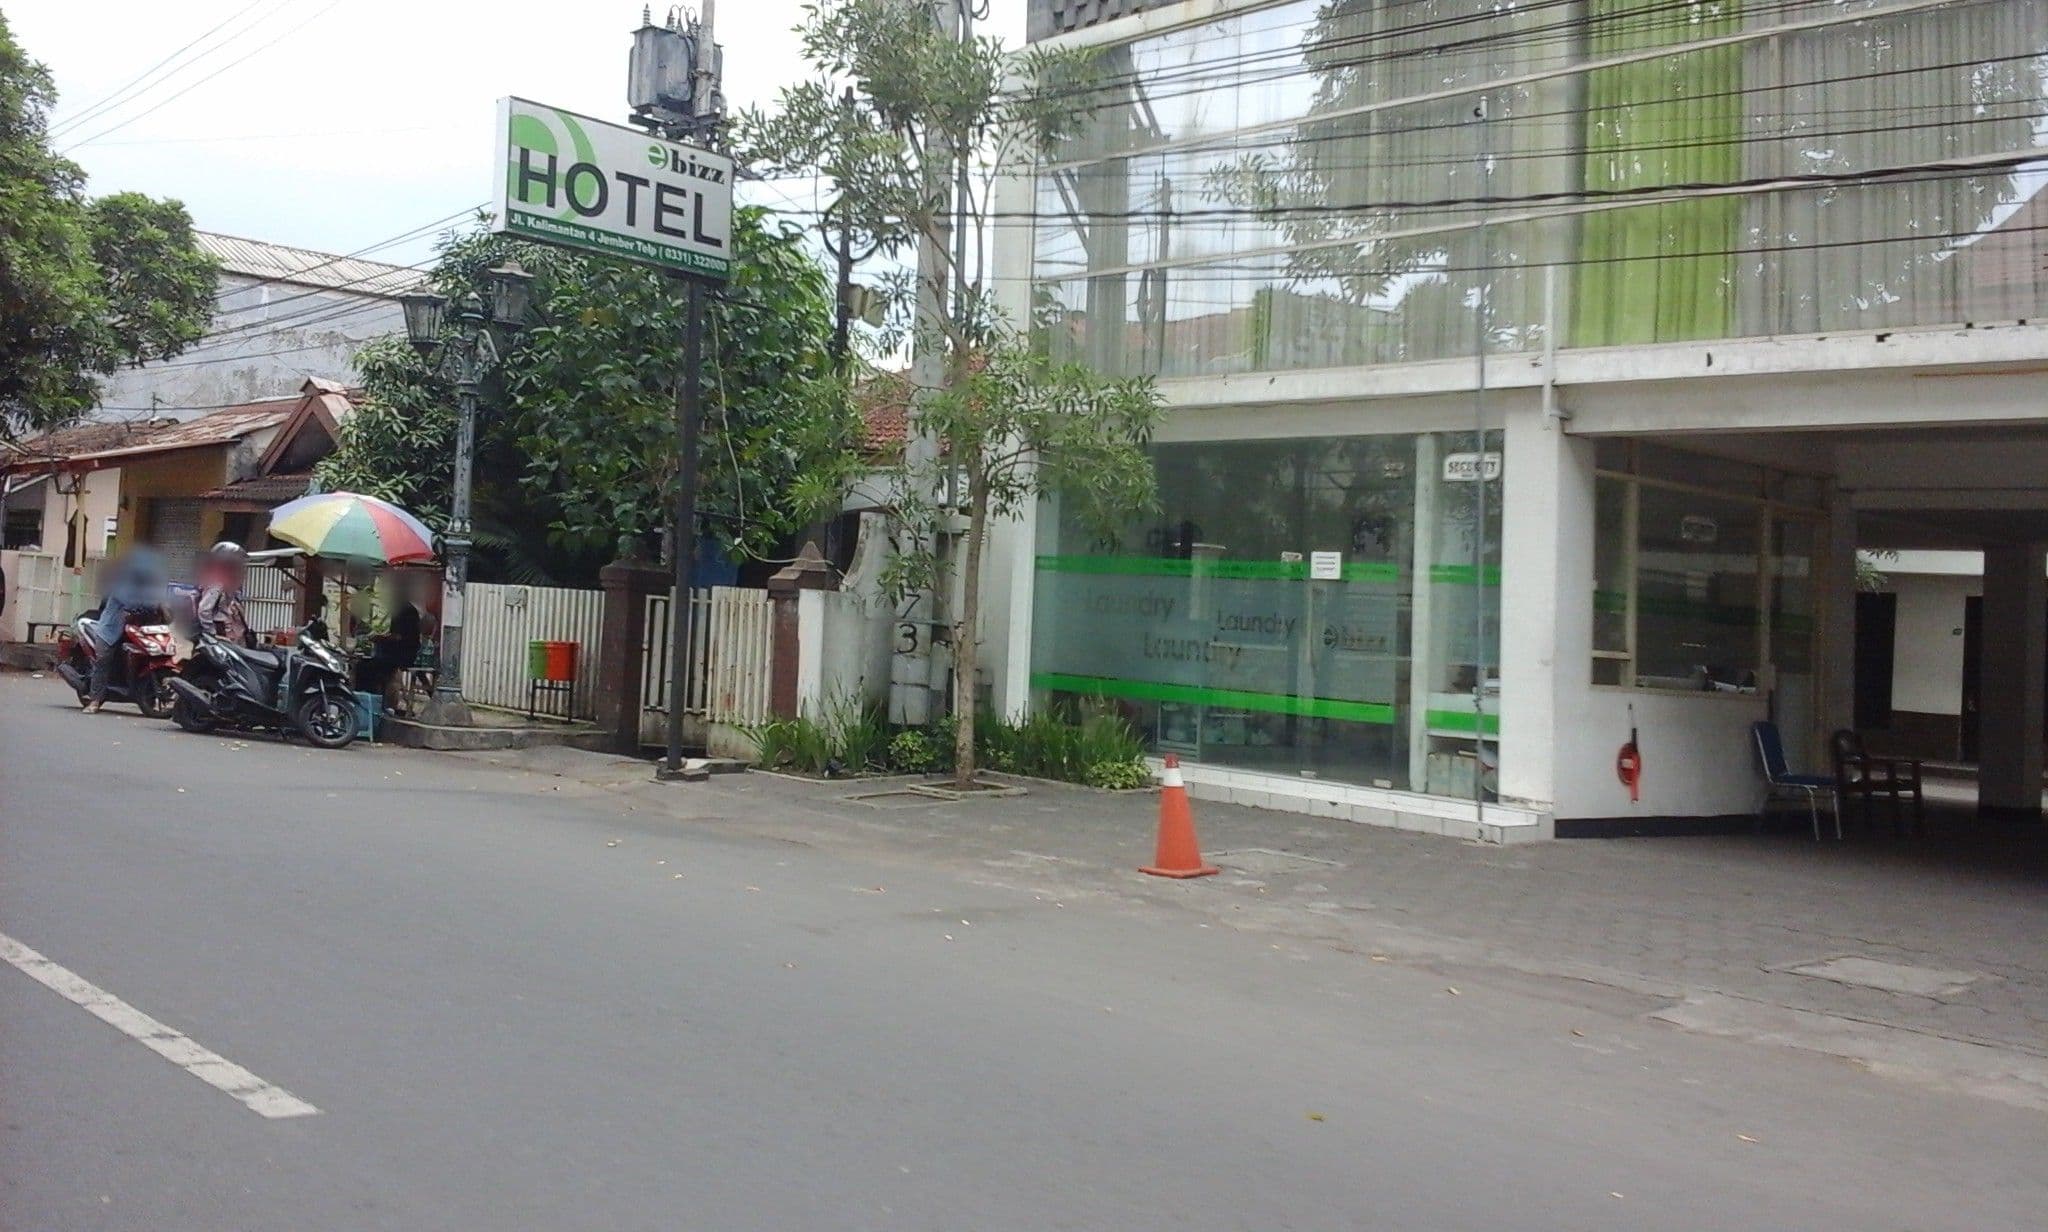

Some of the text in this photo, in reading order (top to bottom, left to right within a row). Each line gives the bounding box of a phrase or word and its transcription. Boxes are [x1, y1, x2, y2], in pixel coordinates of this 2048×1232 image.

[517, 146, 722, 248] HOTEL
[526, 215, 587, 240] Kalimantan
[587, 230, 595, 242] 4
[597, 231, 635, 251] Jember
[635, 240, 658, 258] Telp
[1217, 607, 1296, 638] Laundry
